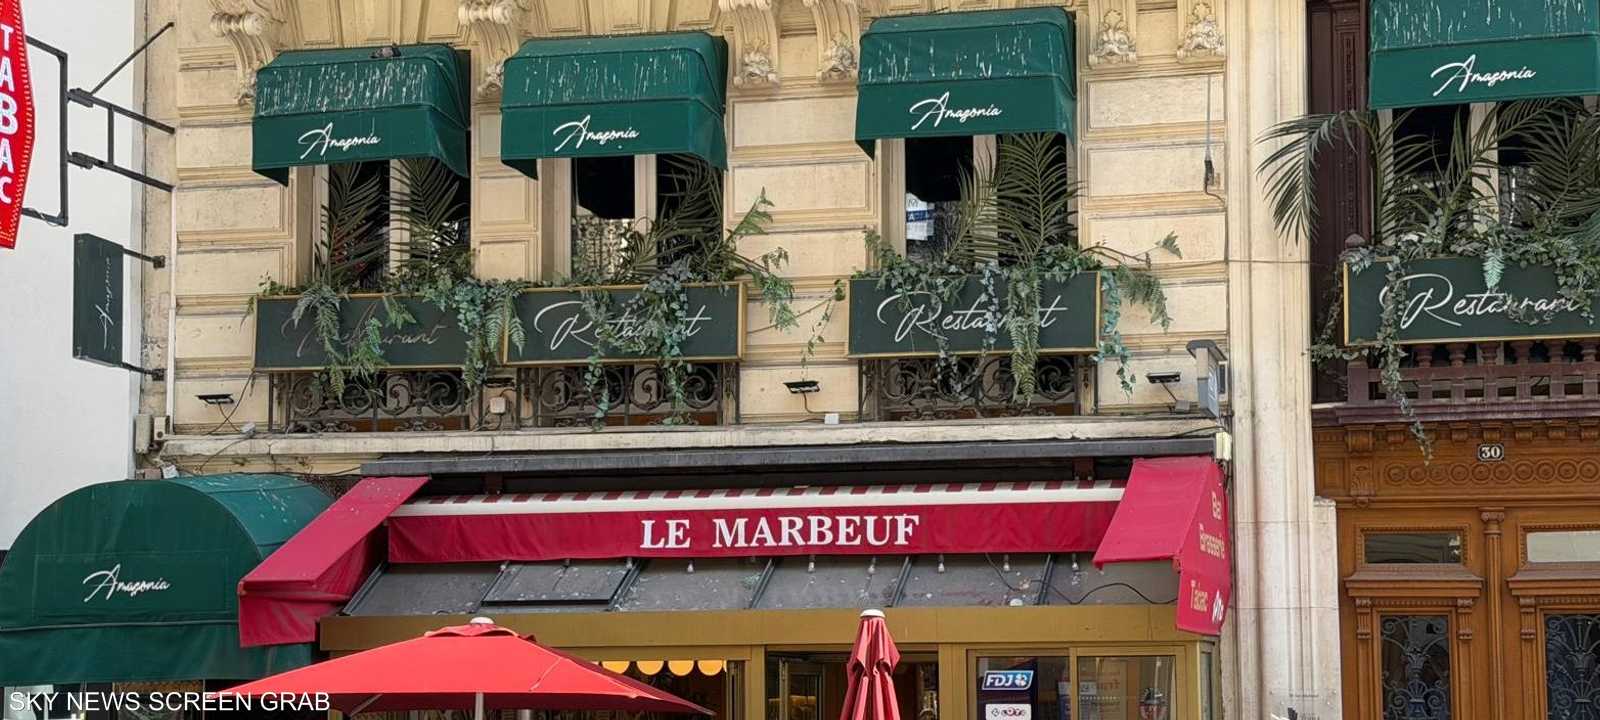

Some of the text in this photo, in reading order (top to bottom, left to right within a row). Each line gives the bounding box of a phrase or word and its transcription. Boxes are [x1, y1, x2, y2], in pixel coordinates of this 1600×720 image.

[0, 23, 18, 204] TABAC
[877, 291, 1068, 342] Restart
[1481, 446, 1501, 458] 30
[640, 514, 919, 548] LE MARBEUF
[986, 674, 1014, 687] FDJ
